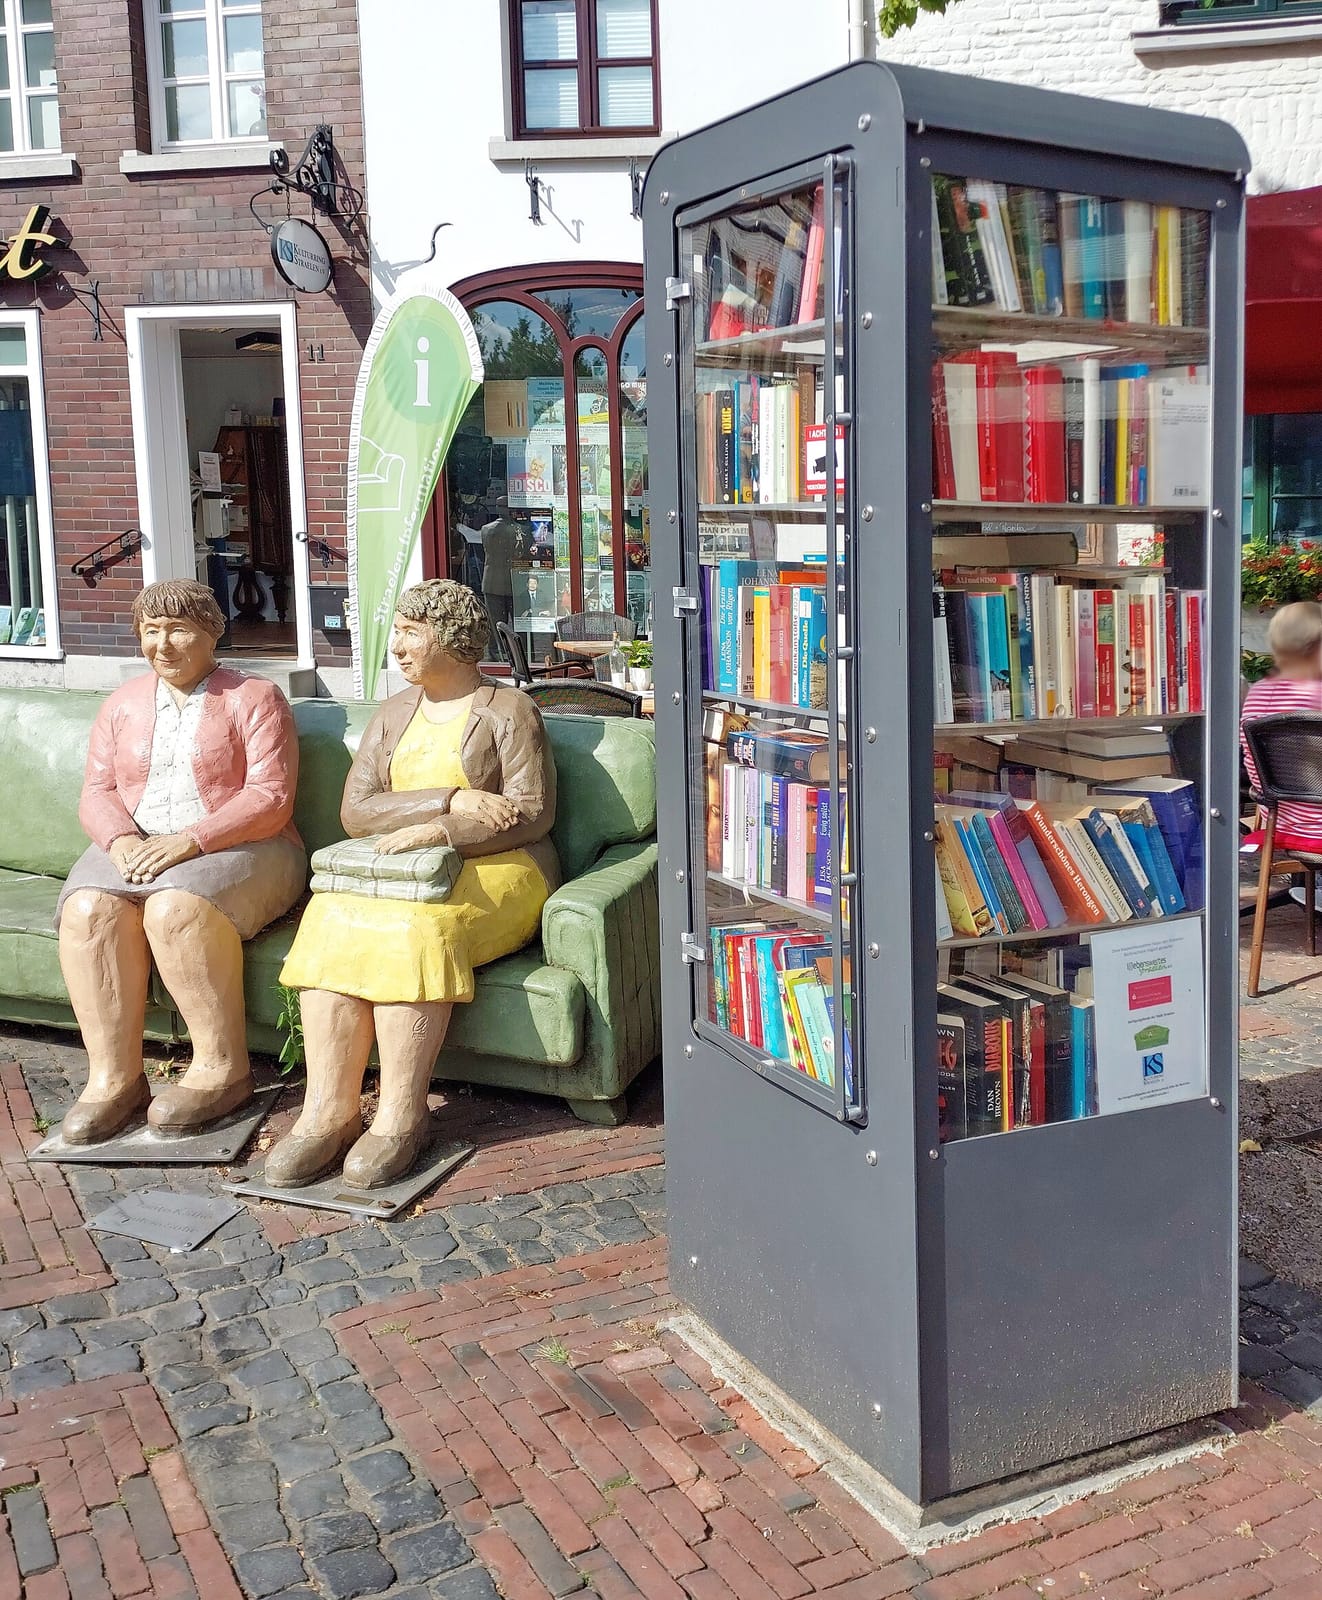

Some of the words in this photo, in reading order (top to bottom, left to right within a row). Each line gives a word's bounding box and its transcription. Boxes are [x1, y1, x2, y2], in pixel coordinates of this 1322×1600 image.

[293, 242, 326, 265] KULTURRING
[294, 254, 319, 273] STRAELEN
[306, 343, 326, 362] 11
[721, 407, 732, 434] TOXIC
[514, 479, 552, 492] DISCO
[373, 550, 405, 625] Straelen
[399, 436, 443, 552] Information
[741, 577, 780, 587] JOHANNS
[726, 587, 735, 610] Rügen
[938, 592, 946, 617] PIPER
[725, 630, 733, 675] JOHANNSON
[1033, 810, 1076, 877] Wunderschönes
[1073, 874, 1100, 917] Herongen
[984, 1018, 1002, 1073] DIABOLUS
[1143, 1052, 1164, 1077] KS
